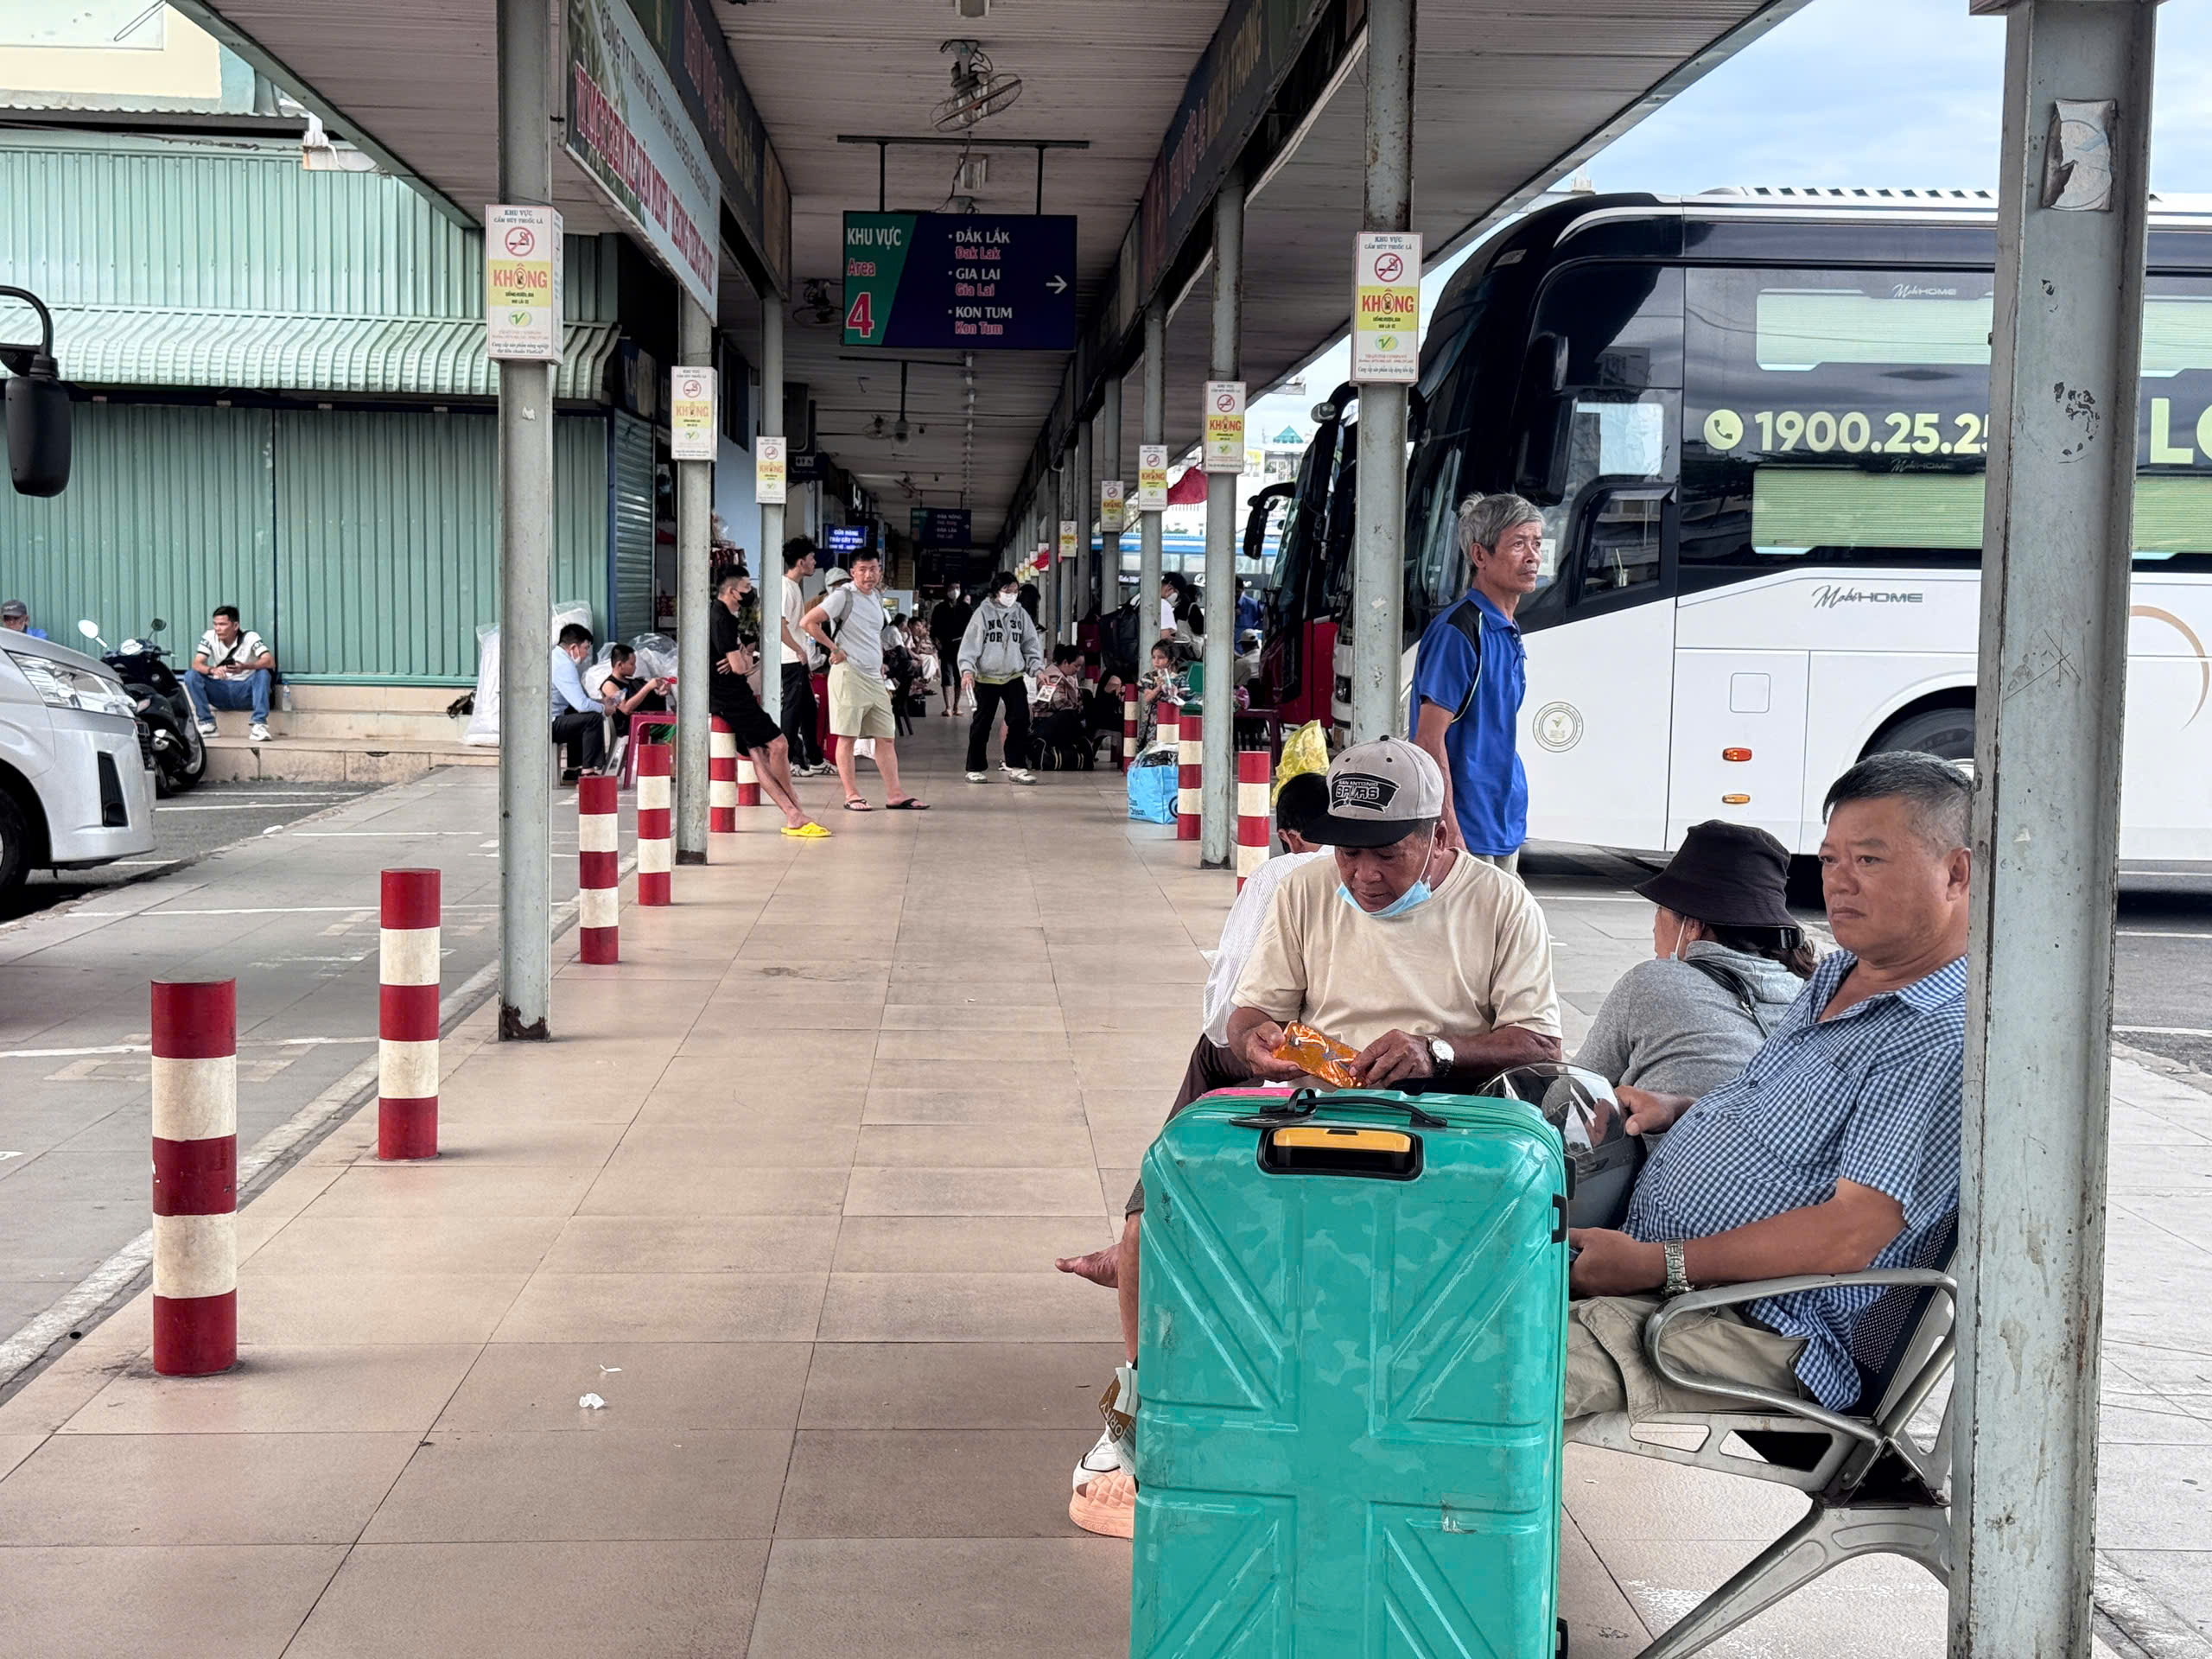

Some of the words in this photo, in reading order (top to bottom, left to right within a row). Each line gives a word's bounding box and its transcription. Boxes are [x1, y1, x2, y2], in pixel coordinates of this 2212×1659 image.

[847, 227, 873, 246] KHU
[875, 226, 902, 250] VỰC
[956, 226, 982, 244] ĐẮK
[986, 226, 1010, 244] LẮK
[980, 246, 1001, 260] Lak
[848, 257, 876, 277] Area
[956, 268, 978, 280] GIA
[982, 268, 1001, 280] LAI
[493, 263, 548, 289] KHÔNG
[955, 283, 976, 296] Gia
[977, 283, 995, 296] Lai
[1362, 287, 1414, 315] KHÔNG
[847, 291, 875, 338] 4
[956, 306, 982, 319] KON
[985, 307, 1013, 319] TUM
[955, 321, 977, 335] Kon
[979, 321, 1003, 335] Tum
[676, 402, 709, 419] KHÔNG
[1210, 416, 1242, 432] KHÔNG
[1754, 410, 1989, 454] 1900.25.2
[2150, 397, 2212, 465] L
[1811, 585, 1923, 608] MobiHOME
[1009, 620, 1022, 629] 30
[1336, 785, 1379, 799] SPURS
